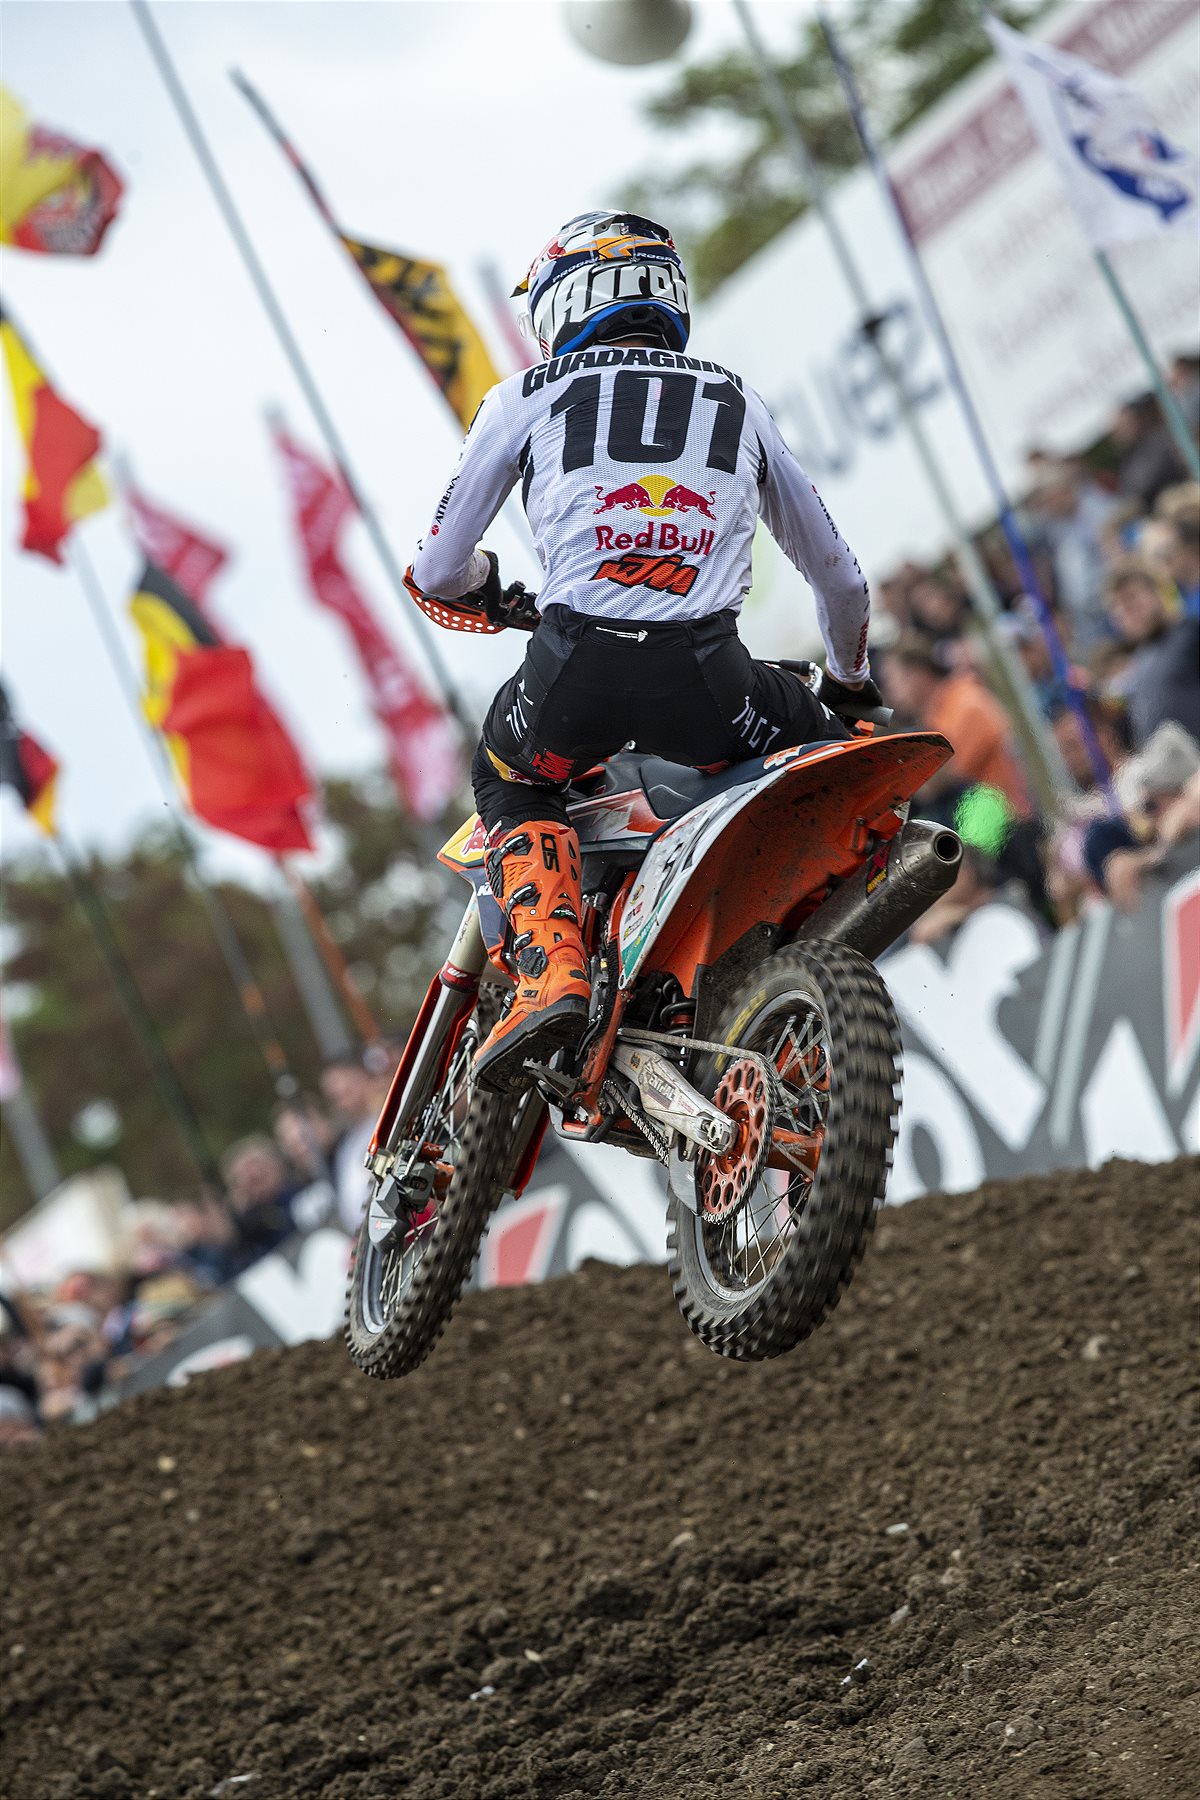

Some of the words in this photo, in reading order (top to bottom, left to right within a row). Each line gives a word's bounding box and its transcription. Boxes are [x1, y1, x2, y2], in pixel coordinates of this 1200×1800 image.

[550, 370, 746, 475] 101
[594, 521, 654, 551] Red
[658, 522, 716, 556] Bull
[590, 552, 700, 598] KTM
